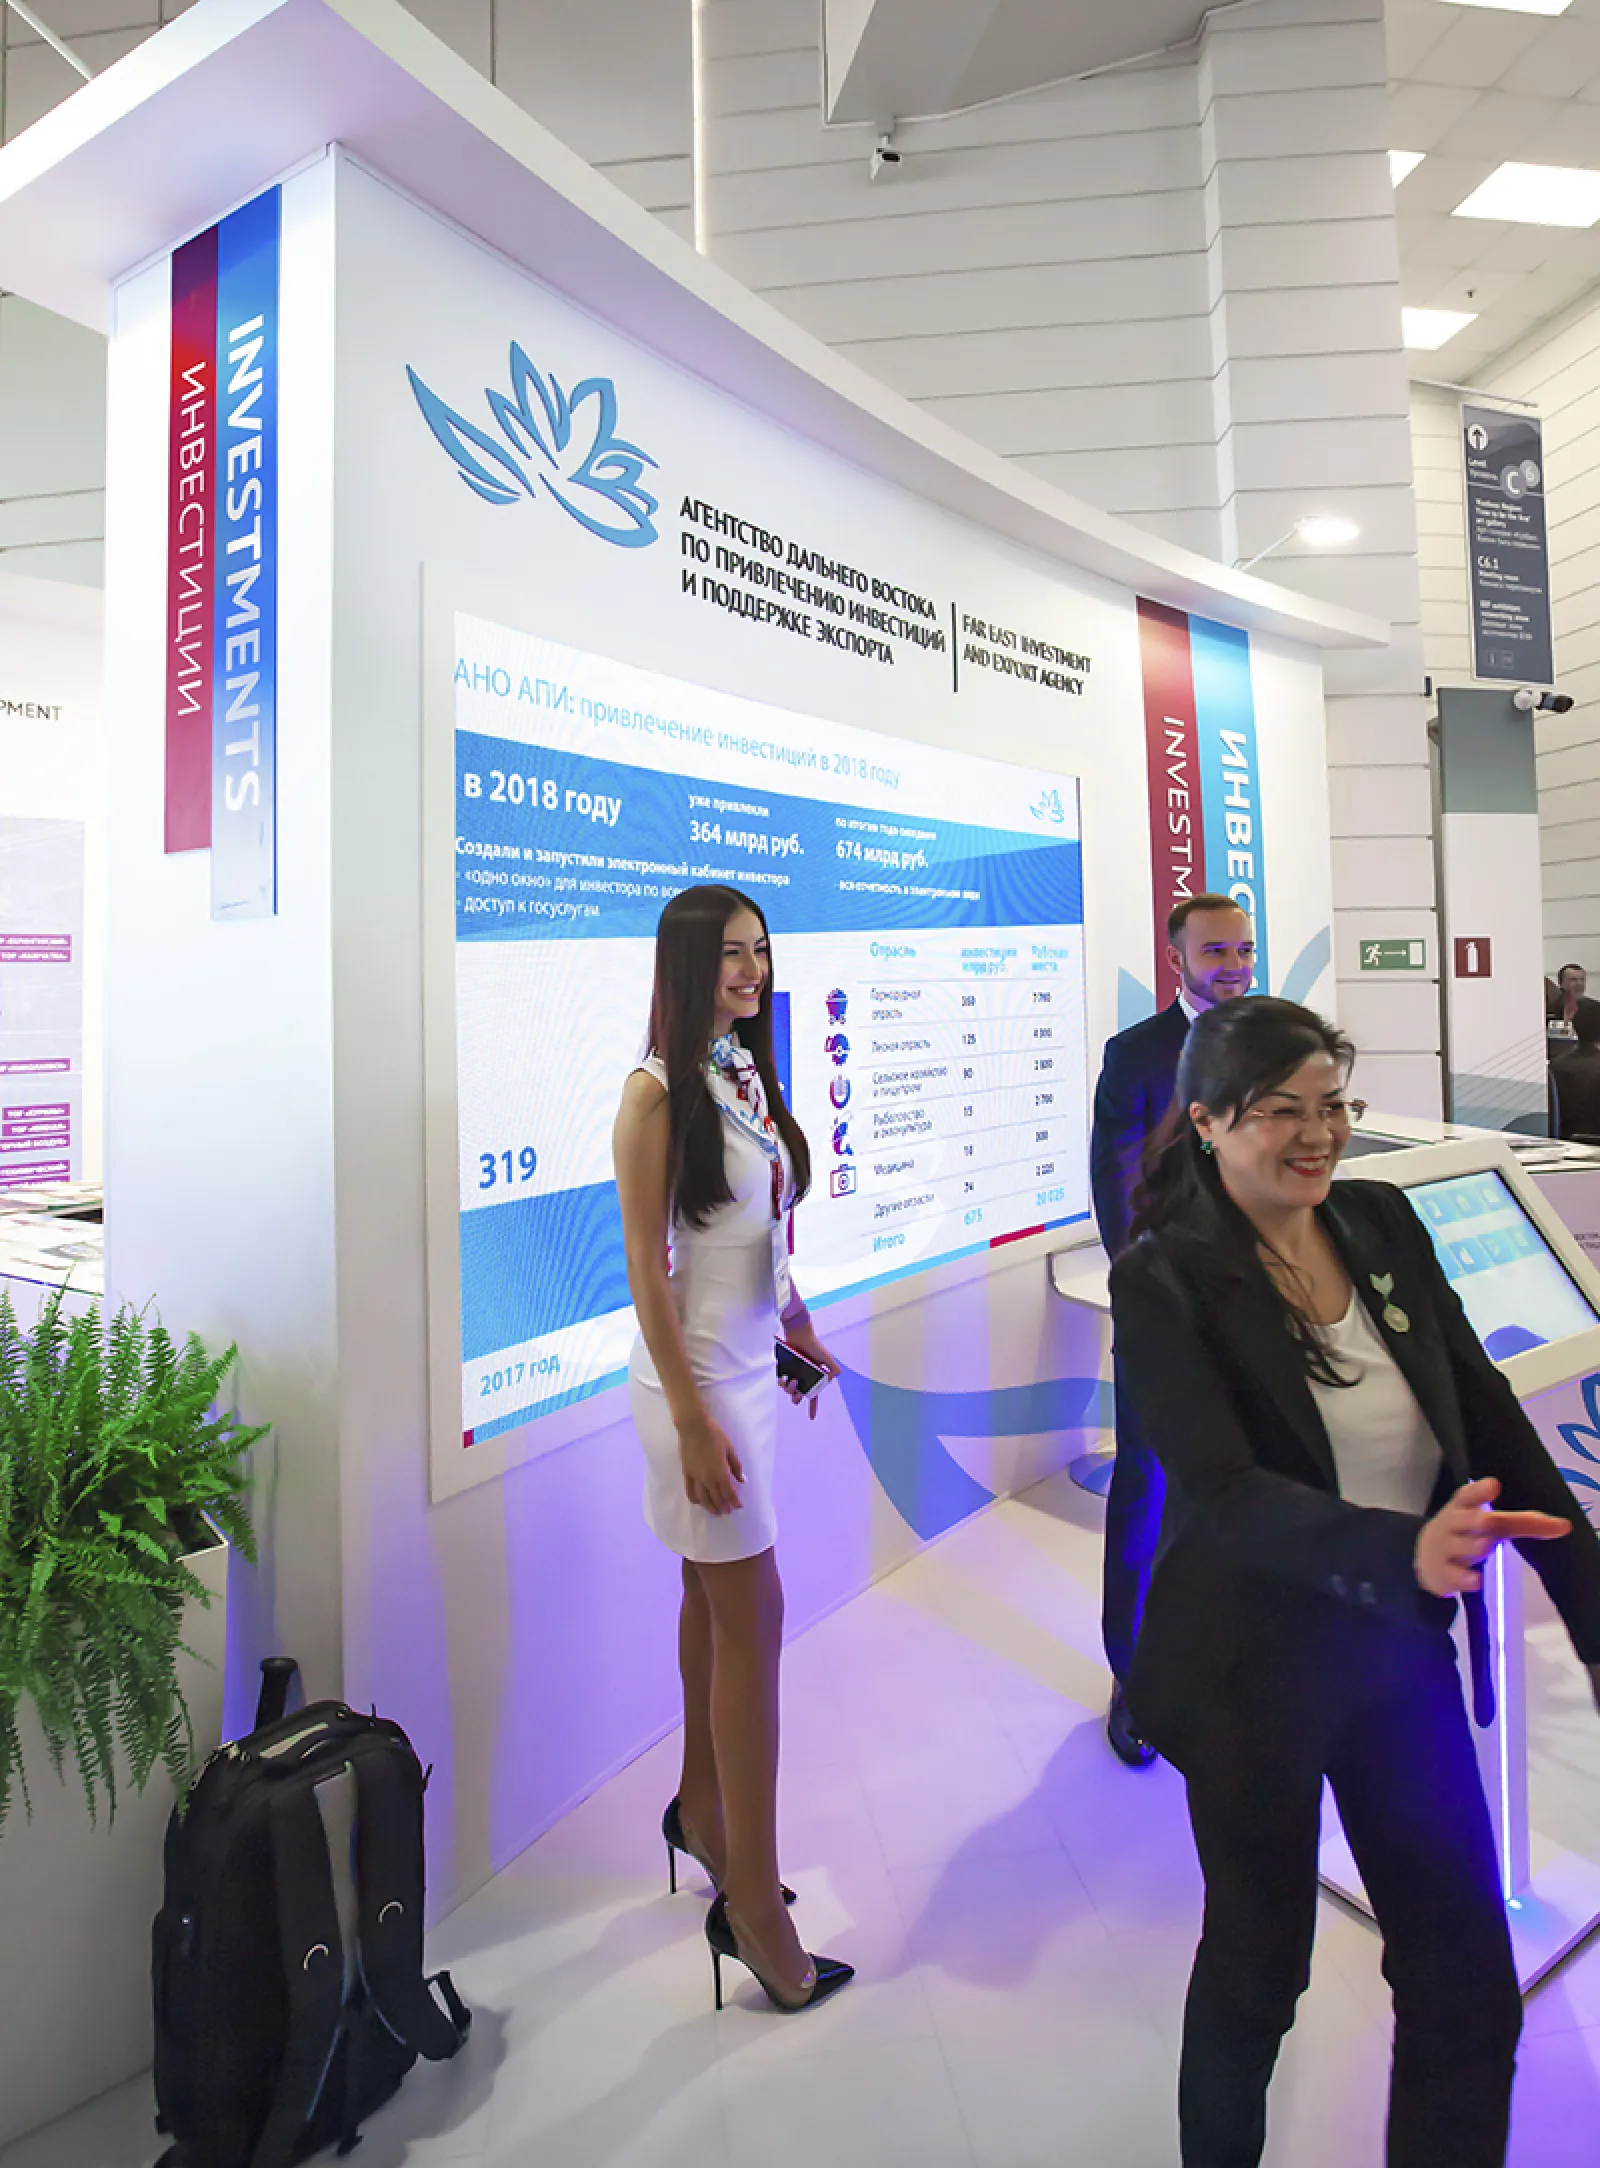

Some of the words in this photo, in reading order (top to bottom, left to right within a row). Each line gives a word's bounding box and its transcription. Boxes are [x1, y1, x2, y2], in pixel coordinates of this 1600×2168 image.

[176, 362, 207, 717] ИНВЕСТИЦИИ
[223, 314, 265, 812] INVESTMENTS
[680, 495, 783, 559] АГЕНТСТВО
[786, 541, 869, 593] ДАЛЬНЕГО
[872, 577, 937, 620] ВОСТОКА
[681, 531, 711, 563] ПО
[715, 545, 846, 617] ПРИВЛЕЧЕНИЮ
[848, 598, 947, 653] ИНВЕСТИЦИЙ
[681, 568, 698, 597] И
[703, 575, 811, 639] ПОДДЕРЖКЕ
[816, 618, 895, 666] ЭКСПОРТА
[962, 613, 987, 639] FAR
[989, 623, 1018, 650] EAST
[1020, 634, 1092, 674] INVESTMENT
[963, 643, 991, 668] AND
[992, 651, 1038, 683] EXPORT
[1039, 667, 1084, 697] AGENCY
[454, 657, 511, 697] АНО
[517, 675, 575, 714] АПИ:
[579, 696, 714, 747] привлечение
[717, 730, 817, 769] инвестиций
[819, 755, 830, 771] в
[832, 753, 869, 779] 2018
[869, 764, 900, 790] году
[463, 772, 482, 798] в
[489, 769, 559, 811] 2018
[564, 789, 622, 828] году
[1163, 715, 1194, 912] INVESTM
[455, 836, 521, 861] Создали
[523, 848, 534, 861] и
[535, 849, 605, 869] запустили
[607, 857, 689, 876] электронный
[691, 863, 736, 881] кабинет
[737, 871, 791, 888] инвестора
[689, 819, 723, 845] 364
[725, 829, 769, 855] млрд
[771, 833, 805, 858] руб.
[835, 839, 862, 860] 674
[863, 847, 901, 869] млрд
[901, 849, 929, 871] руб.
[464, 896, 515, 917] доступ
[528, 900, 600, 920] госуслугам
[579, 880, 642, 898] инвестора
[643, 885, 660, 898] по
[870, 942, 917, 960] Отрасль
[478, 1146, 537, 1190] 319
[479, 1363, 525, 1396] 2017
[529, 1354, 561, 1376] год
